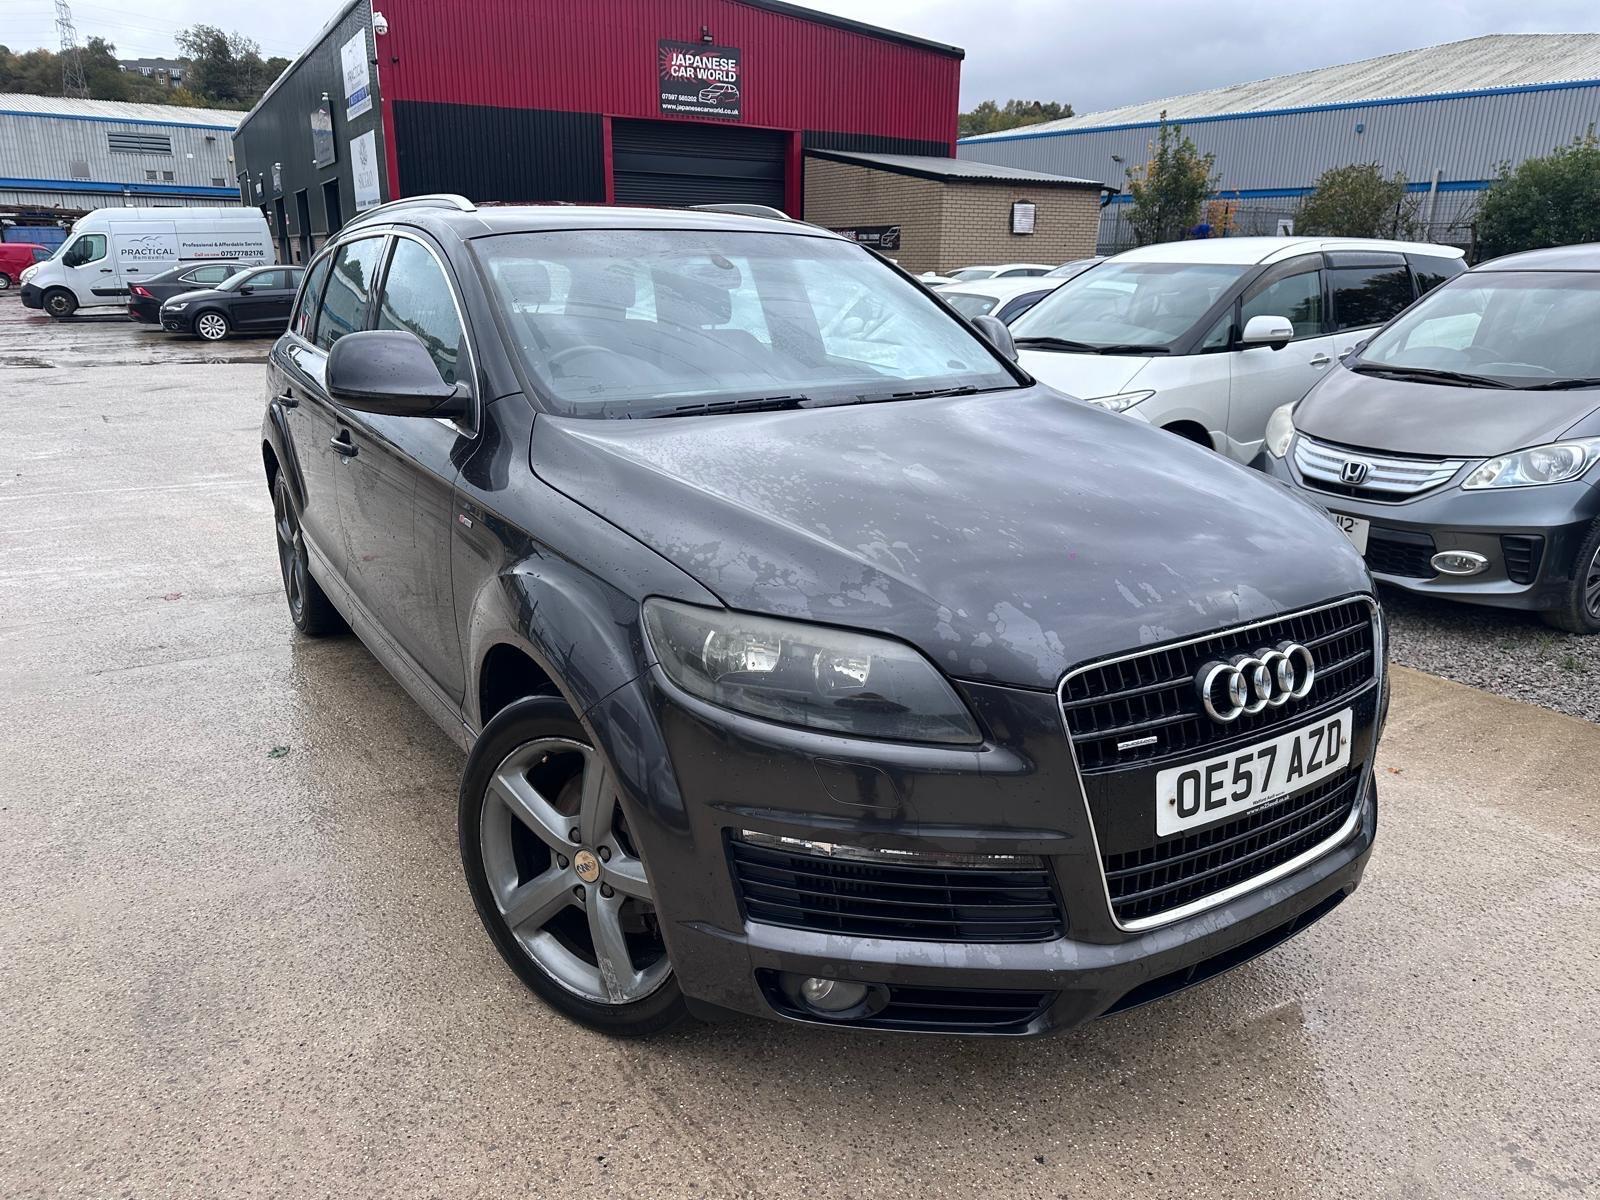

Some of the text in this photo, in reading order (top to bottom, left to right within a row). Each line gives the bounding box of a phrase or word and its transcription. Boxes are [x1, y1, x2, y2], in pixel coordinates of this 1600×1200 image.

[671, 53, 736, 71] JAPANESE
[671, 66, 736, 82] CAR WORLD
[662, 103, 739, 115] www.japanesecarworld.co.uk
[1176, 719, 1342, 819] OE57 AZD
